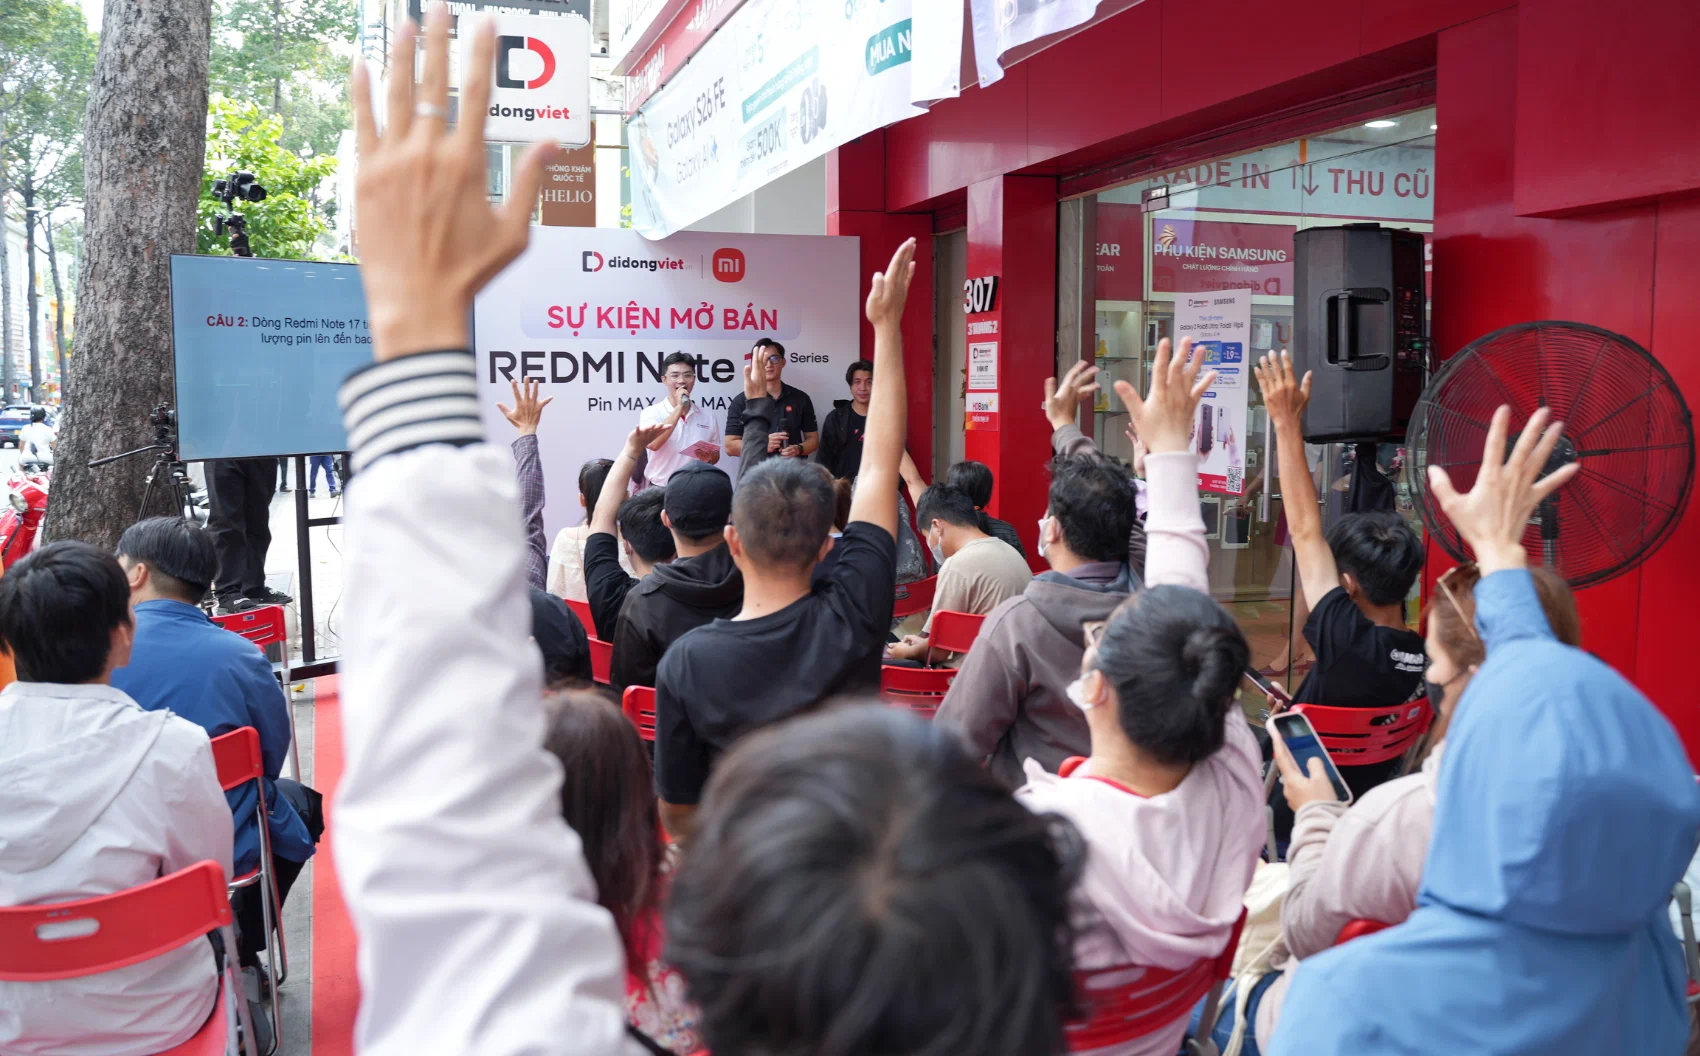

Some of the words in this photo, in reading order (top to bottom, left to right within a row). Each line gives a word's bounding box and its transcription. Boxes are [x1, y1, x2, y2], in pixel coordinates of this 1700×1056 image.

[869, 36, 896, 67] MUA
[897, 29, 911, 53] N
[487, 104, 570, 121] dongviet
[667, 106, 696, 149] Galaxy
[696, 88, 713, 126] S26
[714, 76, 726, 113] FE
[757, 117, 782, 160] 500K
[545, 164, 570, 172] PHÒNG
[571, 164, 592, 173] KHÁM
[552, 173, 574, 182] QUỐC
[575, 173, 585, 182] TẾ
[677, 151, 701, 183] Galaxy
[1242, 162, 1270, 189] IN
[1328, 168, 1384, 196] THU
[1394, 168, 1430, 199] CŨ
[544, 189, 593, 203] HELIO
[1154, 244, 1182, 260] PHỤ
[1185, 243, 1216, 261] KIỆN
[1219, 247, 1287, 262] SAMSUNG
[963, 276, 994, 314] 307
[206, 314, 234, 327] CÂU
[237, 316, 248, 327] 2:
[252, 317, 281, 330] Dòng
[285, 317, 318, 329] Redmi
[321, 319, 345, 330] Note
[349, 320, 359, 329] 17
[547, 302, 588, 337] SỰ
[597, 300, 660, 336] KIỆN
[670, 301, 714, 330] MỞ
[723, 302, 778, 331] BÁN
[261, 333, 293, 346] lượng
[296, 334, 312, 346] pin
[315, 333, 330, 344] lên
[333, 332, 352, 344] đến
[489, 351, 625, 384] REDMI
[636, 351, 735, 384] Nte
[790, 352, 829, 363] Series
[588, 397, 612, 411] Pin
[618, 397, 656, 411] MAX
